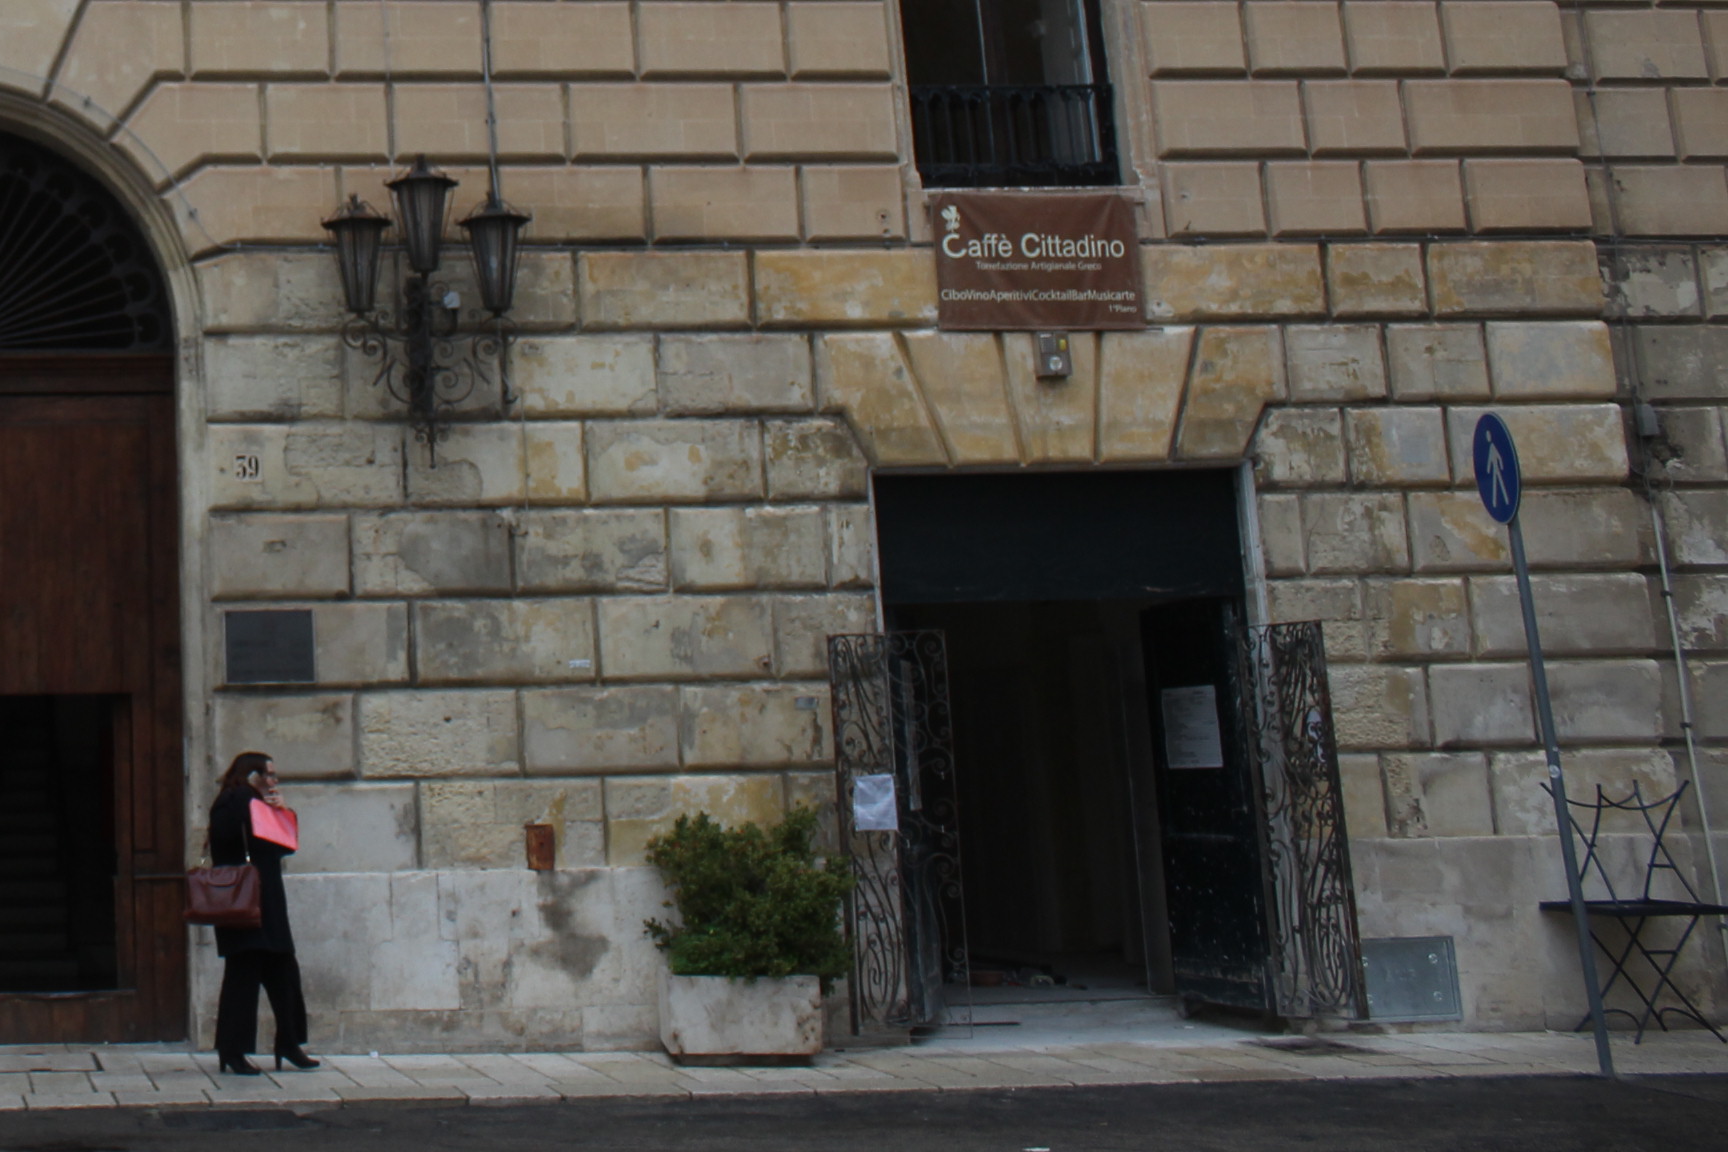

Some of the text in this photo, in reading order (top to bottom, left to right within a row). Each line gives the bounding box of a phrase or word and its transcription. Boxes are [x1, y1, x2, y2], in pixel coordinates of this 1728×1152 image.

[942, 232, 1125, 259] Caffè Cittadino
[235, 454, 260, 479] 39
